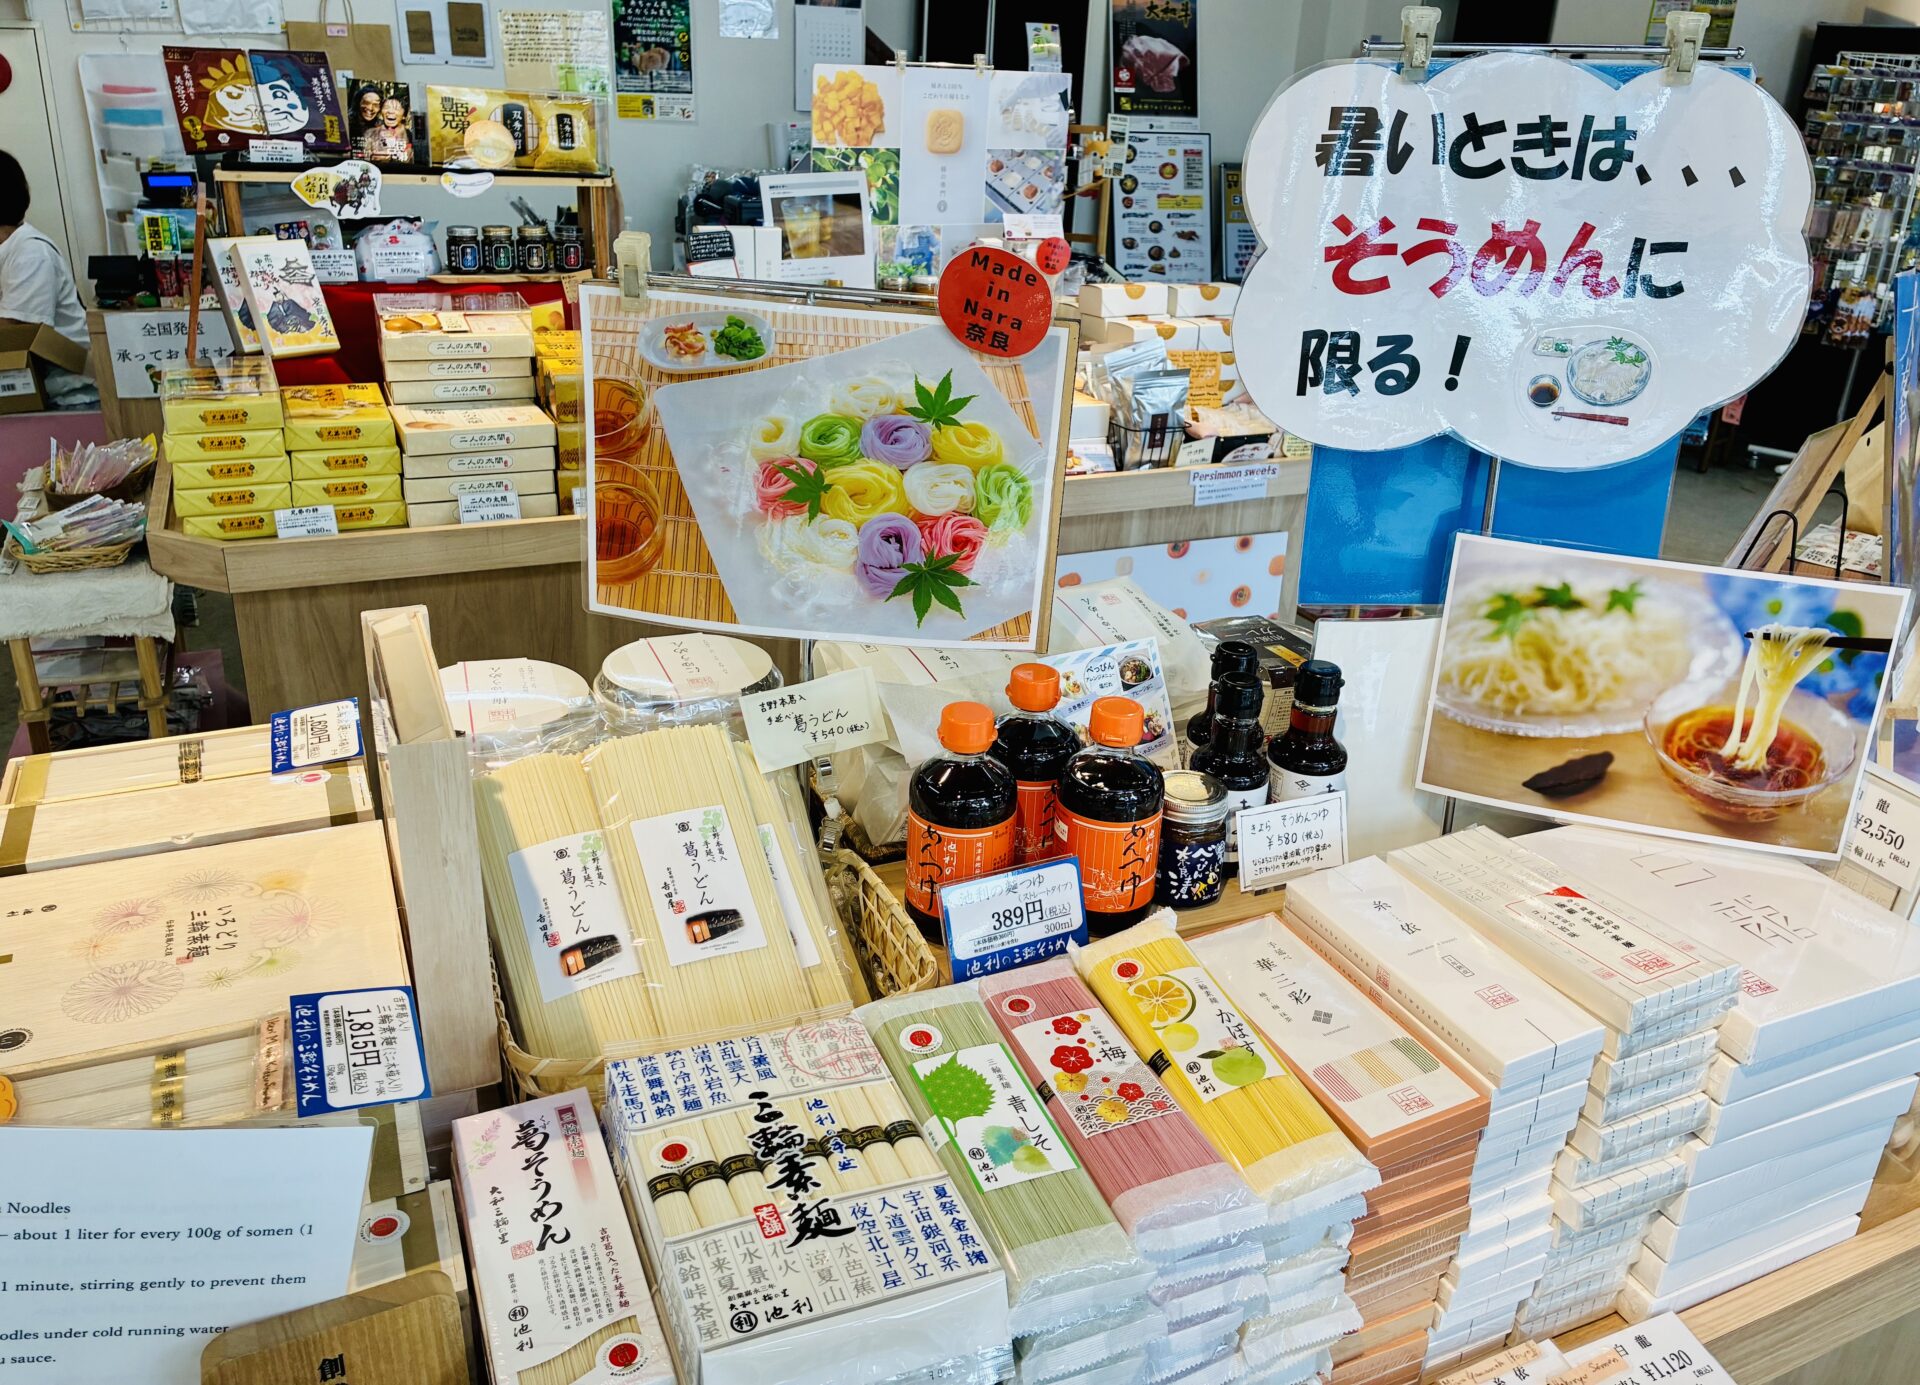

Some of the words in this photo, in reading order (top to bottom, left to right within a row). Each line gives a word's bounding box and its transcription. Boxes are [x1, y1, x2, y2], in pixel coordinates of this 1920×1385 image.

[1315, 105, 1747, 188] 暑いときは、、、
[970, 251, 1037, 287] Made
[1323, 213, 1690, 300] そうめんに
[963, 297, 1023, 331] Nara
[986, 281, 1010, 303] in
[965, 322, 1010, 353] 奈良
[1192, 470, 1242, 483] Persimmon
[1243, 465, 1278, 477] sweets
[793, 707, 849, 734] 葛うどん
[1281, 807, 1330, 829] そうめんつゆ
[683, 840, 715, 907] 葛うどん
[919, 825, 944, 912] めんつゆ
[1119, 823, 1146, 909] めんつゆ
[560, 867, 591, 936] 葛うどん
[215, 904, 239, 951] いろどり
[1044, 918, 1073, 935] 300ml
[1099, 1045, 1127, 1062] 梅
[1216, 1009, 1256, 1057] かぼす
[1007, 1094, 1053, 1151] 青しそ
[510, 1119, 572, 1252] 葛そうめん
[745, 1091, 857, 1249] 三輪素麺
[7, 1202, 71, 1215] Noodles
[757, 1204, 786, 1237] 老舗
[902, 1190, 962, 1273] 宇宙銀河系
[928, 1182, 989, 1268] 夏祭金魚掬
[13, 1229, 58, 1241] about
[64, 1229, 71, 1240] 1
[77, 1228, 109, 1240] liter
[113, 1227, 136, 1240] for
[140, 1229, 181, 1242] every
[186, 1227, 222, 1241] 100g
[226, 1226, 244, 1238] of
[246, 1227, 294, 1238] somen
[299, 1224, 314, 1237] (1
[850, 1202, 906, 1290] 夜空北斗星
[878, 1196, 934, 1281] 入道雲夕立
[703, 1238, 739, 1297] 往来夏
[733, 1230, 770, 1285] 山水景
[837, 1241, 877, 1299] 水芭蕉
[0, 1280, 8, 1292] 1
[15, 1281, 75, 1292] minute,
[80, 1278, 135, 1292] stirring
[140, 1277, 186, 1292] gently
[190, 1278, 206, 1288] to
[210, 1276, 265, 1290] prevent
[271, 1274, 307, 1285] them
[672, 1246, 722, 1342] 風鈴峠茶屋
[44, 1327, 88, 1340] under
[92, 1326, 123, 1338] cold
[128, 1325, 185, 1338] running
[189, 1325, 230, 1335] water
[764, 1296, 814, 1324] 池利
[10, 1353, 57, 1365] sauce.
[513, 1323, 534, 1352] 池利
[1639, 1349, 1693, 1382] ¥1,120
